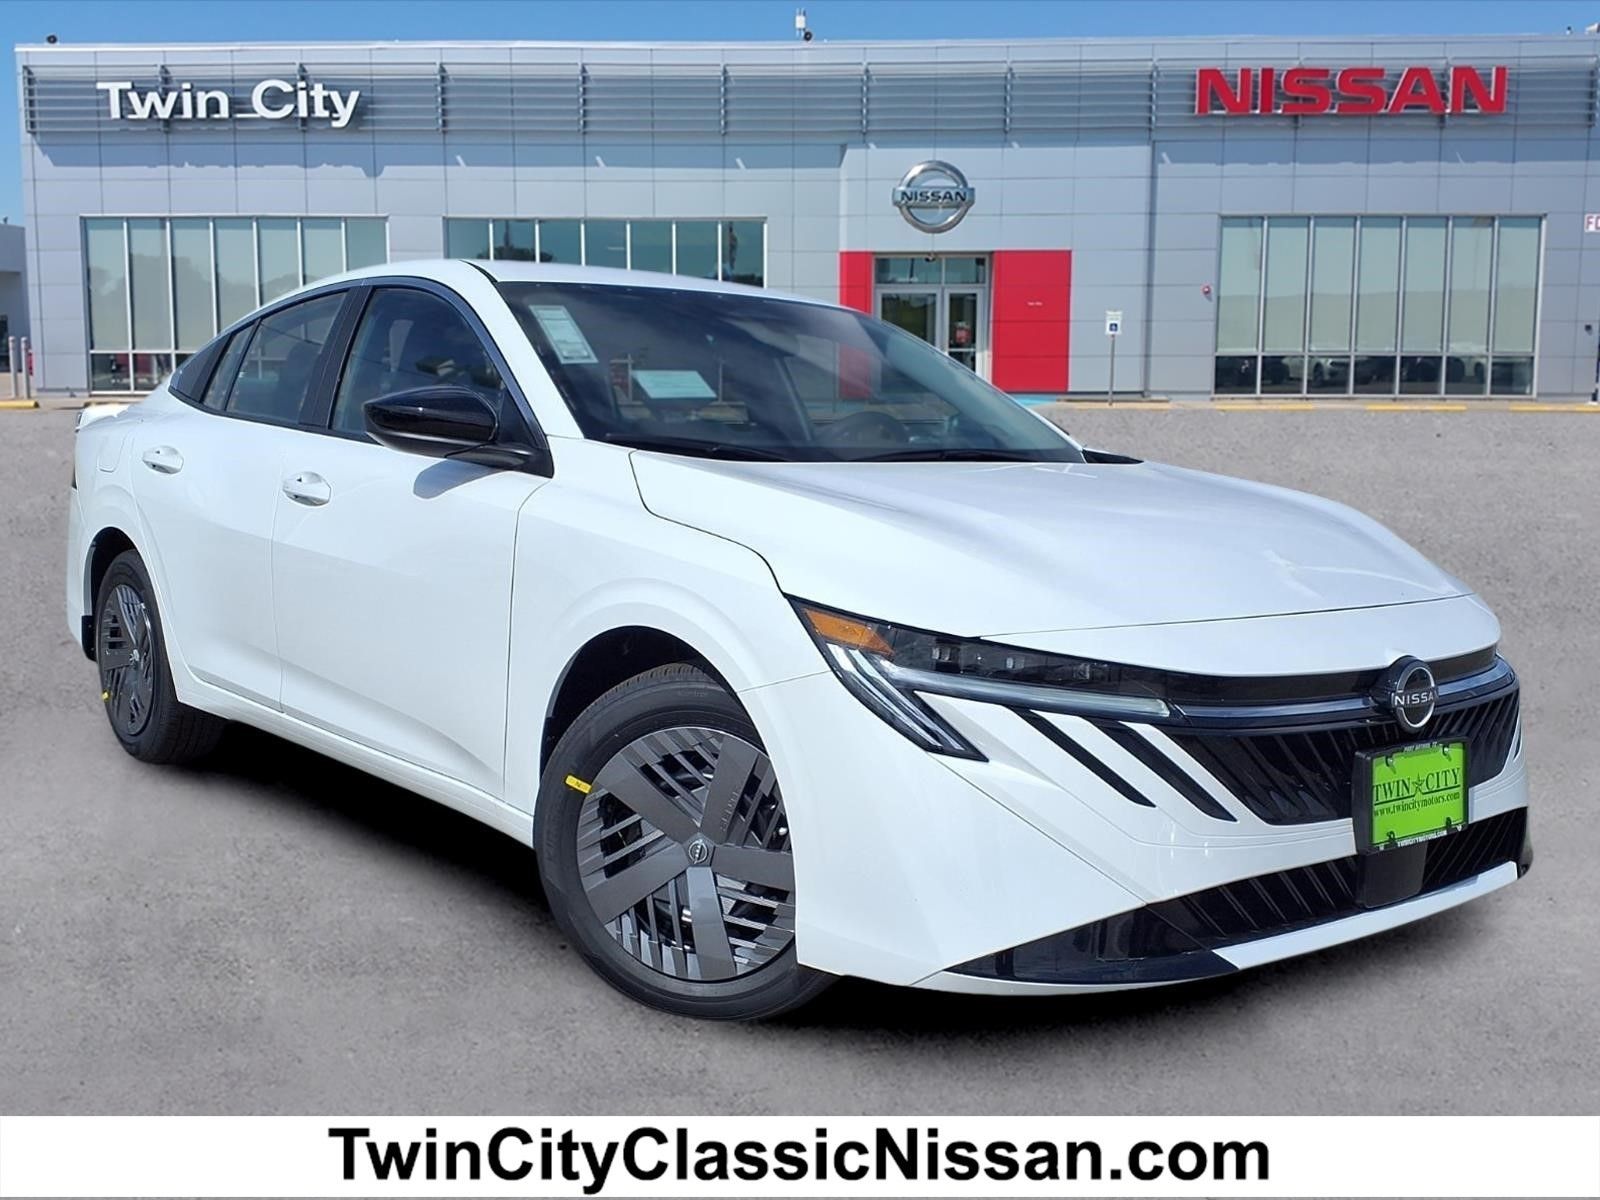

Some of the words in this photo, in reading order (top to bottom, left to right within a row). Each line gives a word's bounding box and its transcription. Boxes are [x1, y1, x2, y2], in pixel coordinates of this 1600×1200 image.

[96, 81, 230, 119] Twin
[251, 79, 361, 128] City
[1195, 66, 1508, 116] NISSAN
[900, 190, 967, 202] NISSAN
[1373, 777, 1411, 802] TWIN
[1425, 767, 1460, 792] CITY
[1374, 791, 1460, 816] www.twincitymotors.com
